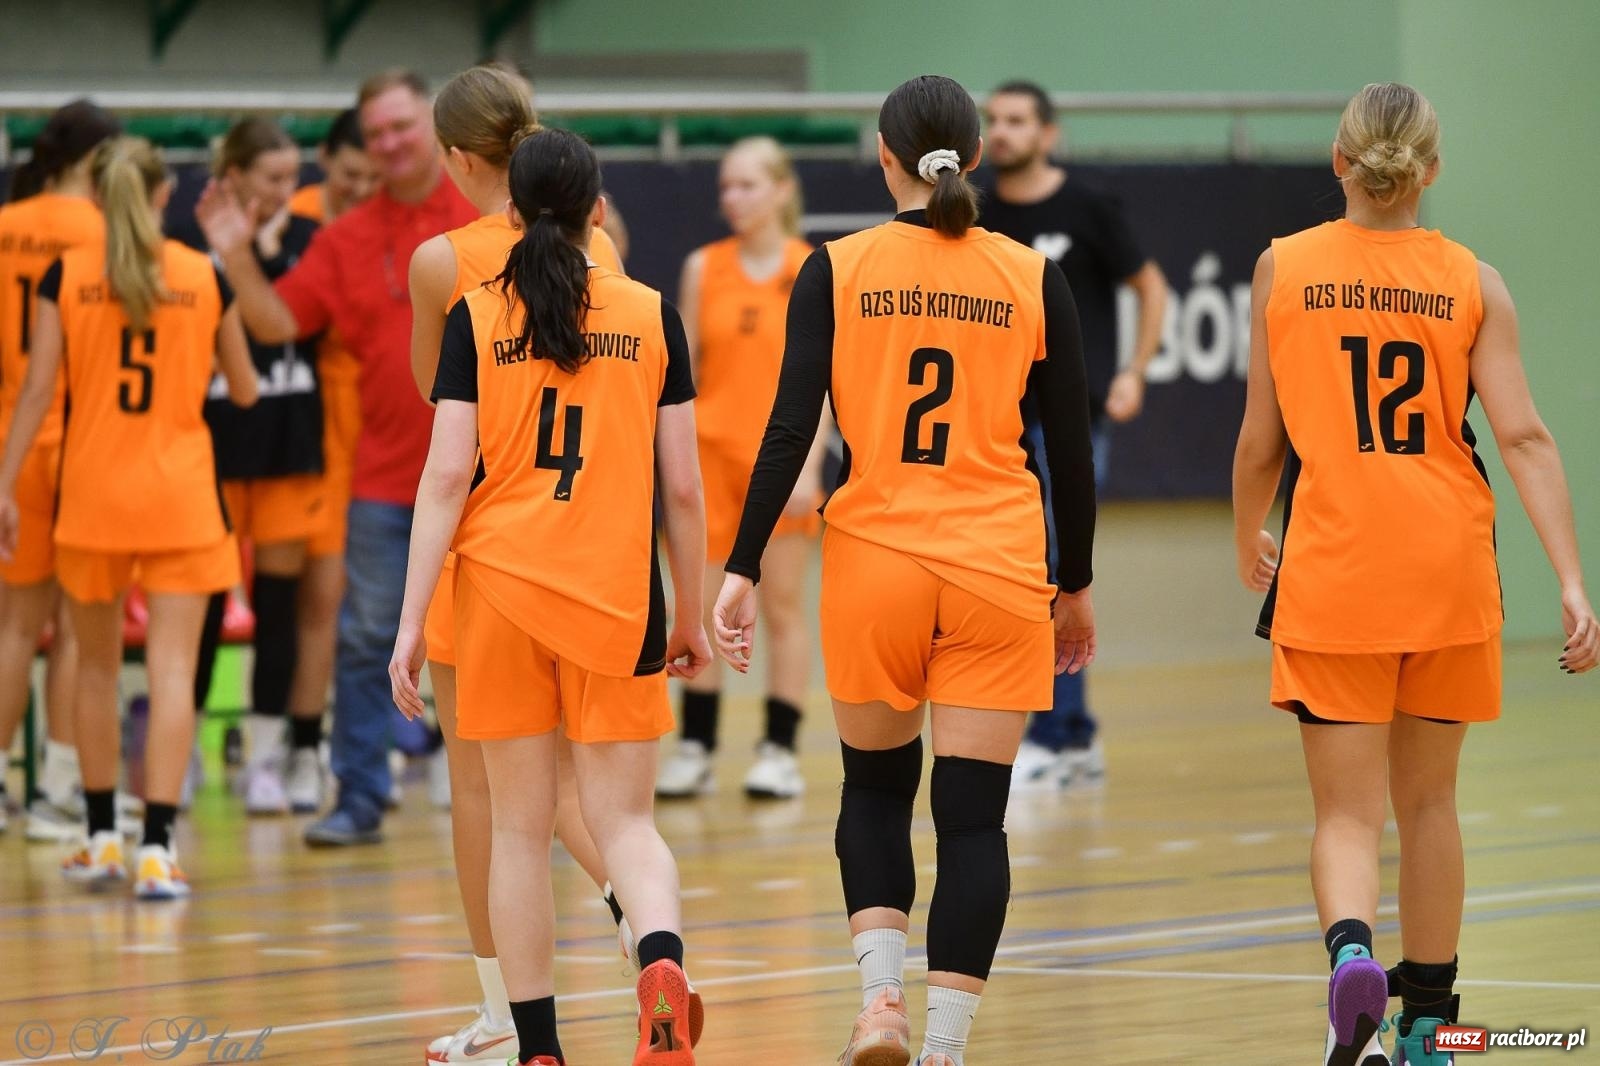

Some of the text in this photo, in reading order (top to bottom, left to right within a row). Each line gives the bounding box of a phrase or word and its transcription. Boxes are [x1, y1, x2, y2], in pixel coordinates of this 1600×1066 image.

[860, 284, 1014, 328] AZS UŚ KATOWICE
[1304, 279, 1455, 321] AZS UŚ KATOWICE
[118, 325, 156, 413] 5
[901, 347, 954, 466] 2
[1340, 335, 1425, 455] 12
[534, 386, 584, 502] 4
